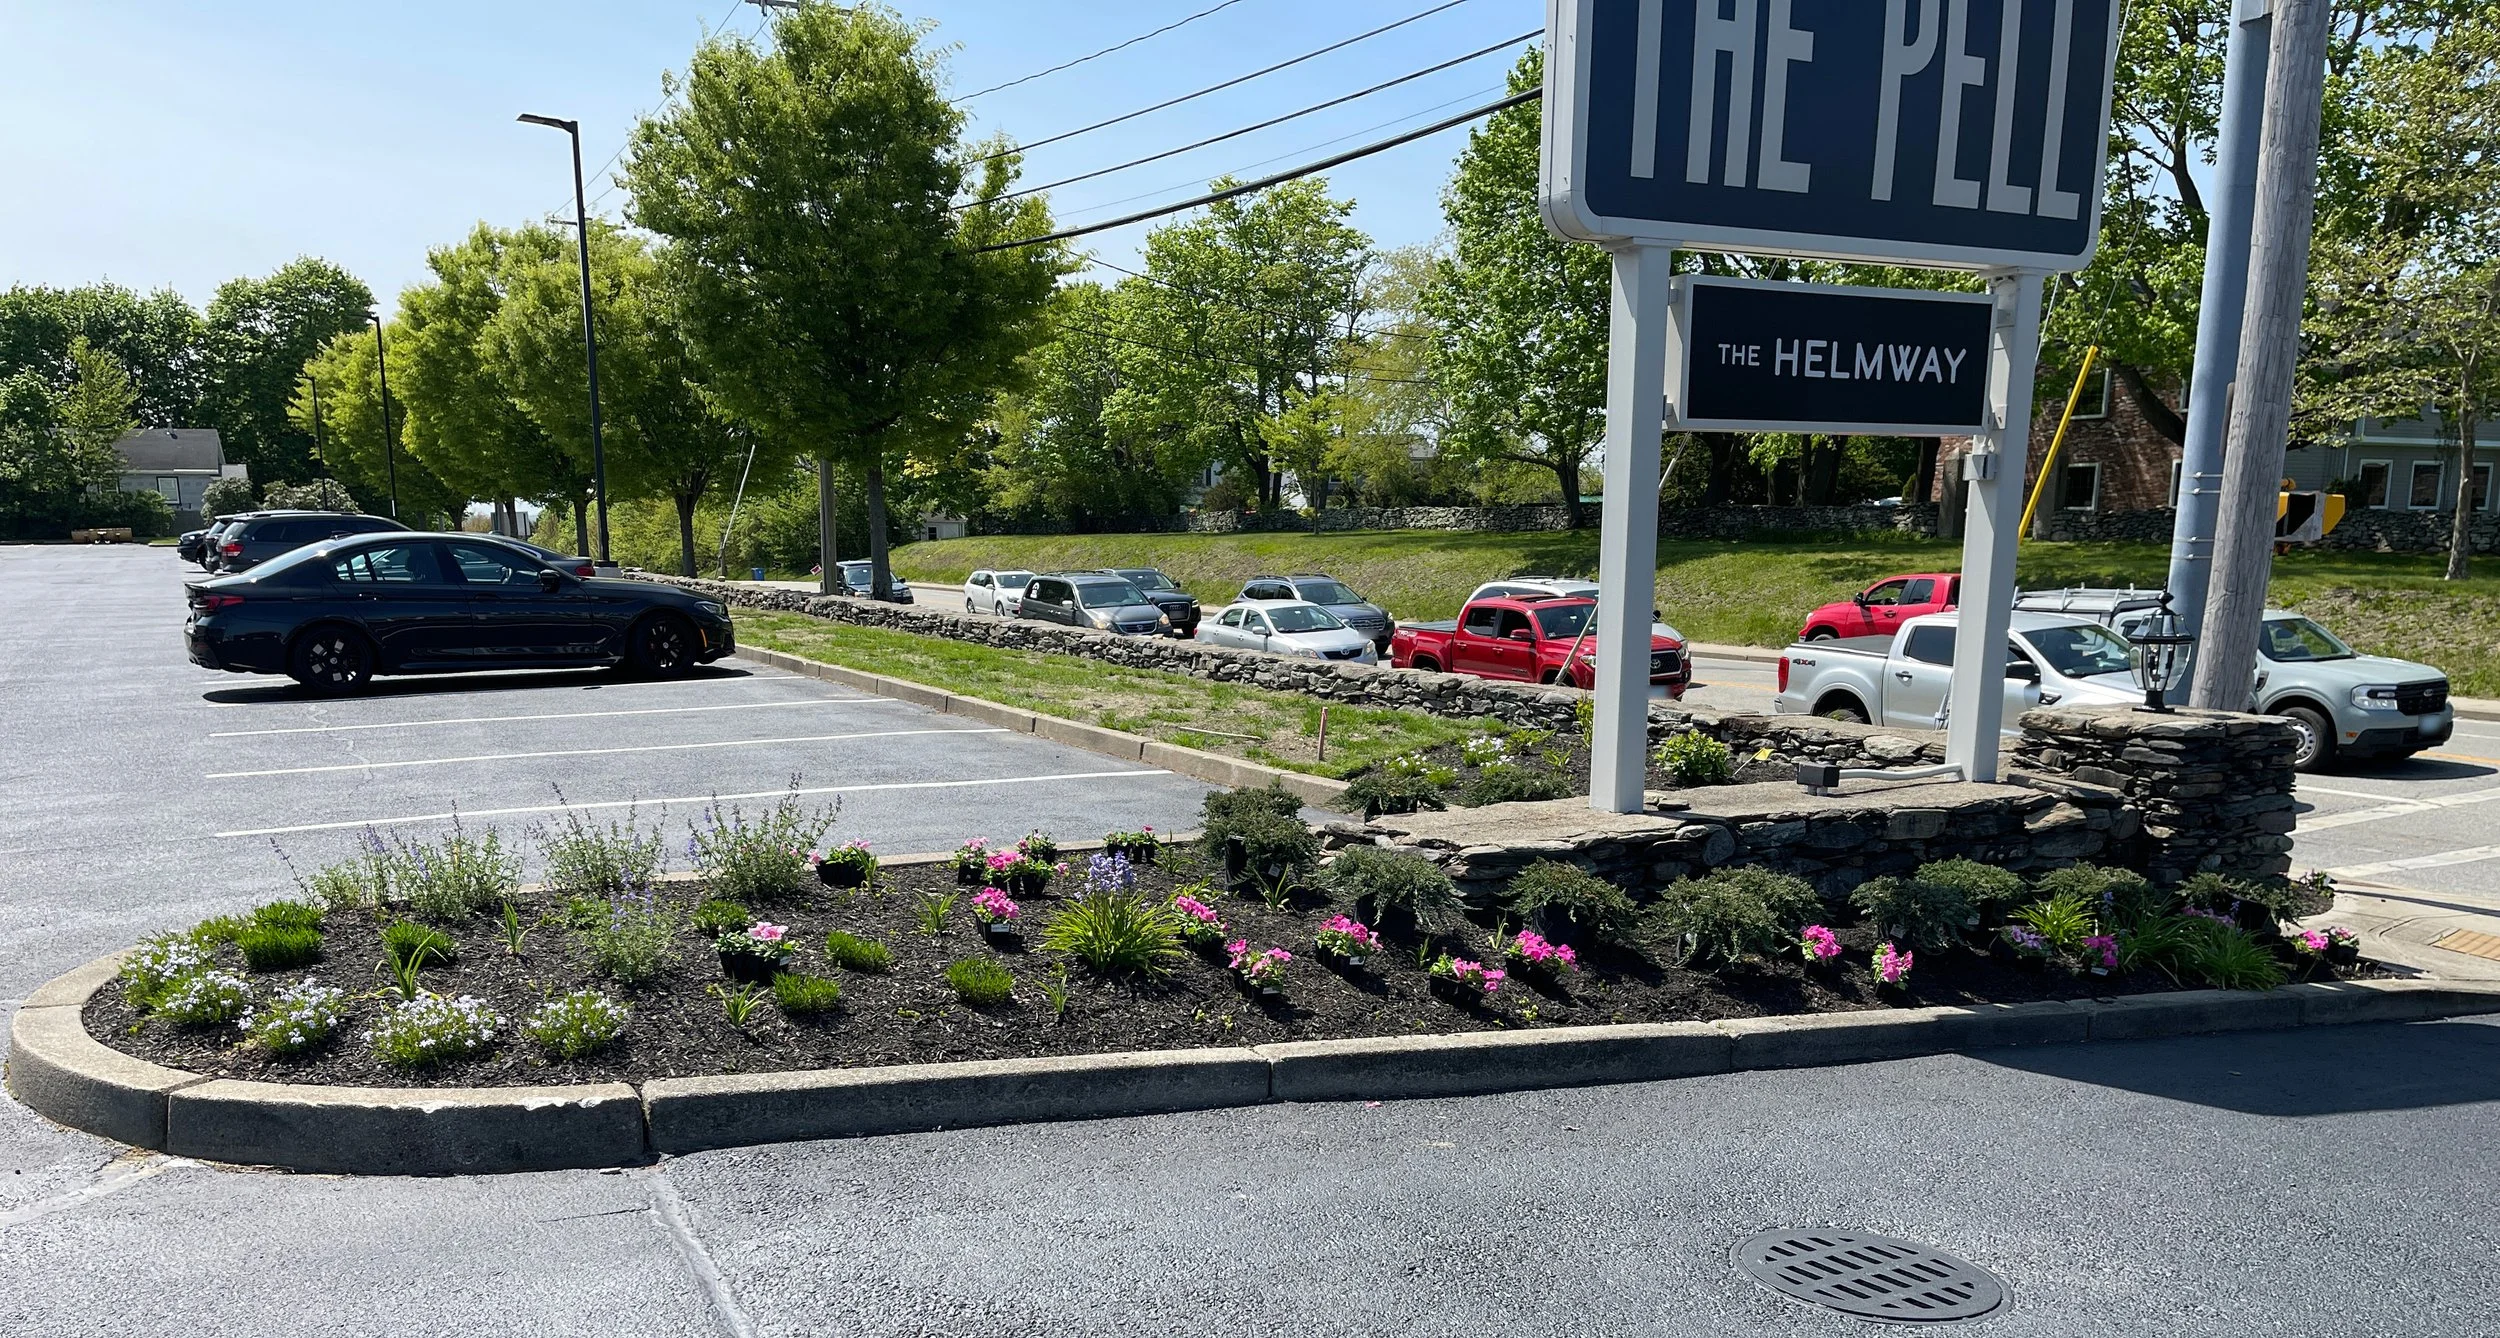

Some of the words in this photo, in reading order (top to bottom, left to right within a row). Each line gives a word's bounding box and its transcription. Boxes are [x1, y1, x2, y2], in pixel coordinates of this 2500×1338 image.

[1871, 0, 2081, 220] PELL
[1718, 343, 1761, 367] THE
[1774, 337, 1967, 384] HELMWAY
